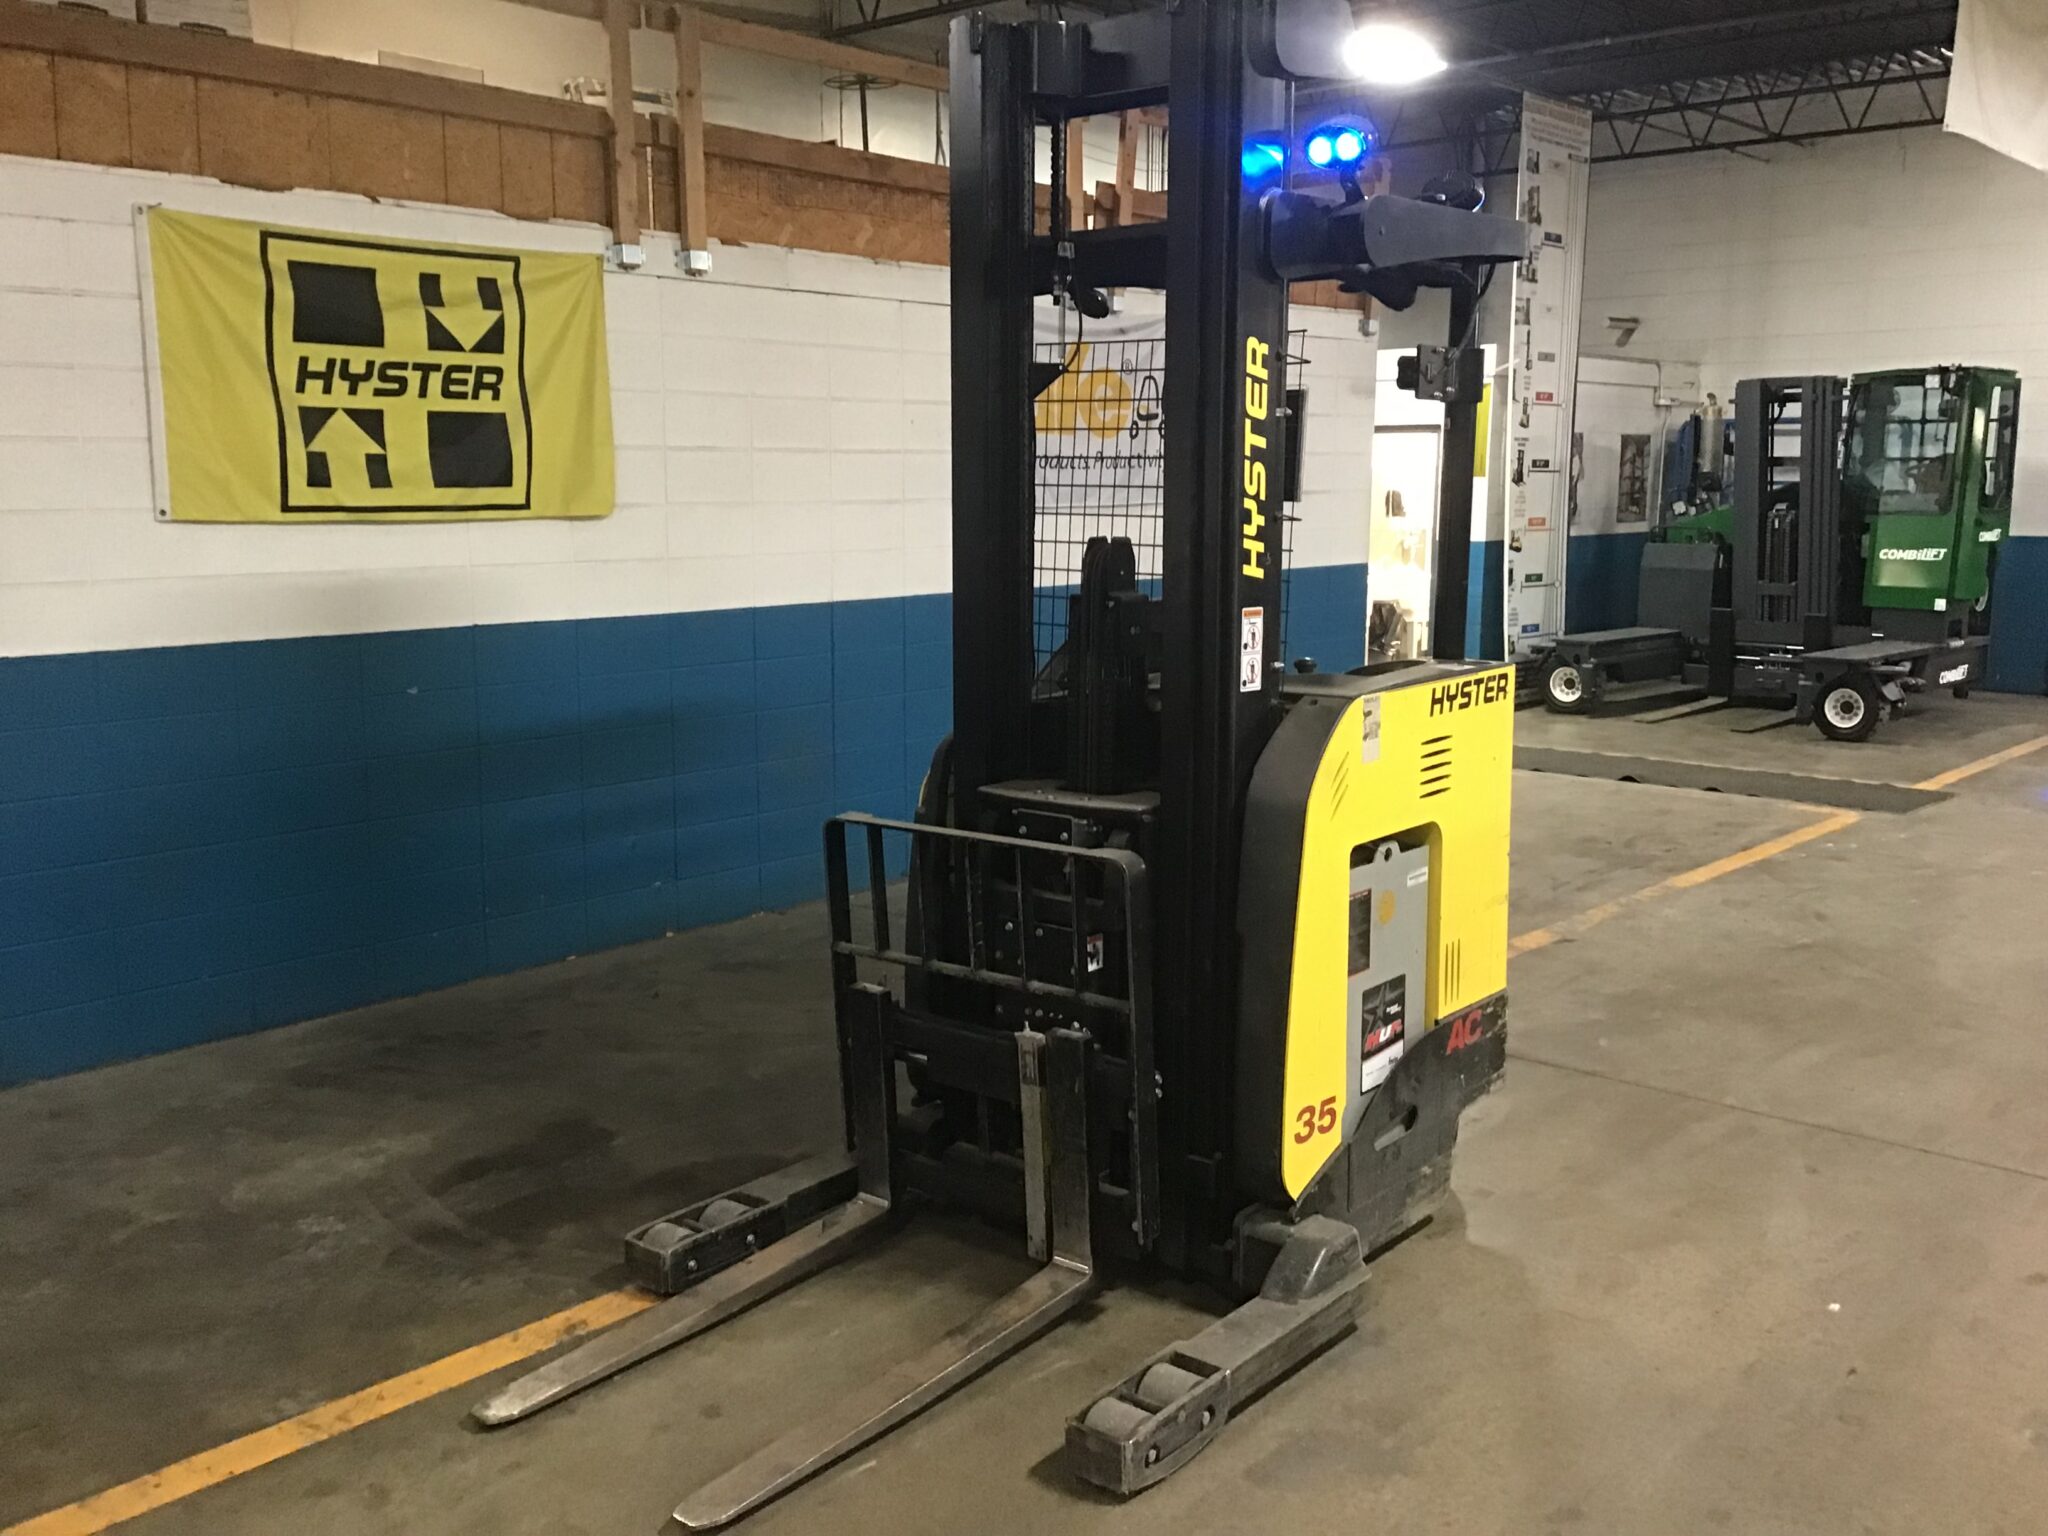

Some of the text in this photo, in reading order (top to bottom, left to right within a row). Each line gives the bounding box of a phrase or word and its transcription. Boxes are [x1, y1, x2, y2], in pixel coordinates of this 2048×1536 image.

[295, 356, 505, 401] HYSTER
[1243, 336, 1269, 580] HYSTER
[1430, 672, 1509, 717] HYSTER
[1446, 1009, 1483, 1056] AC
[1293, 1096, 1337, 1145] 35
